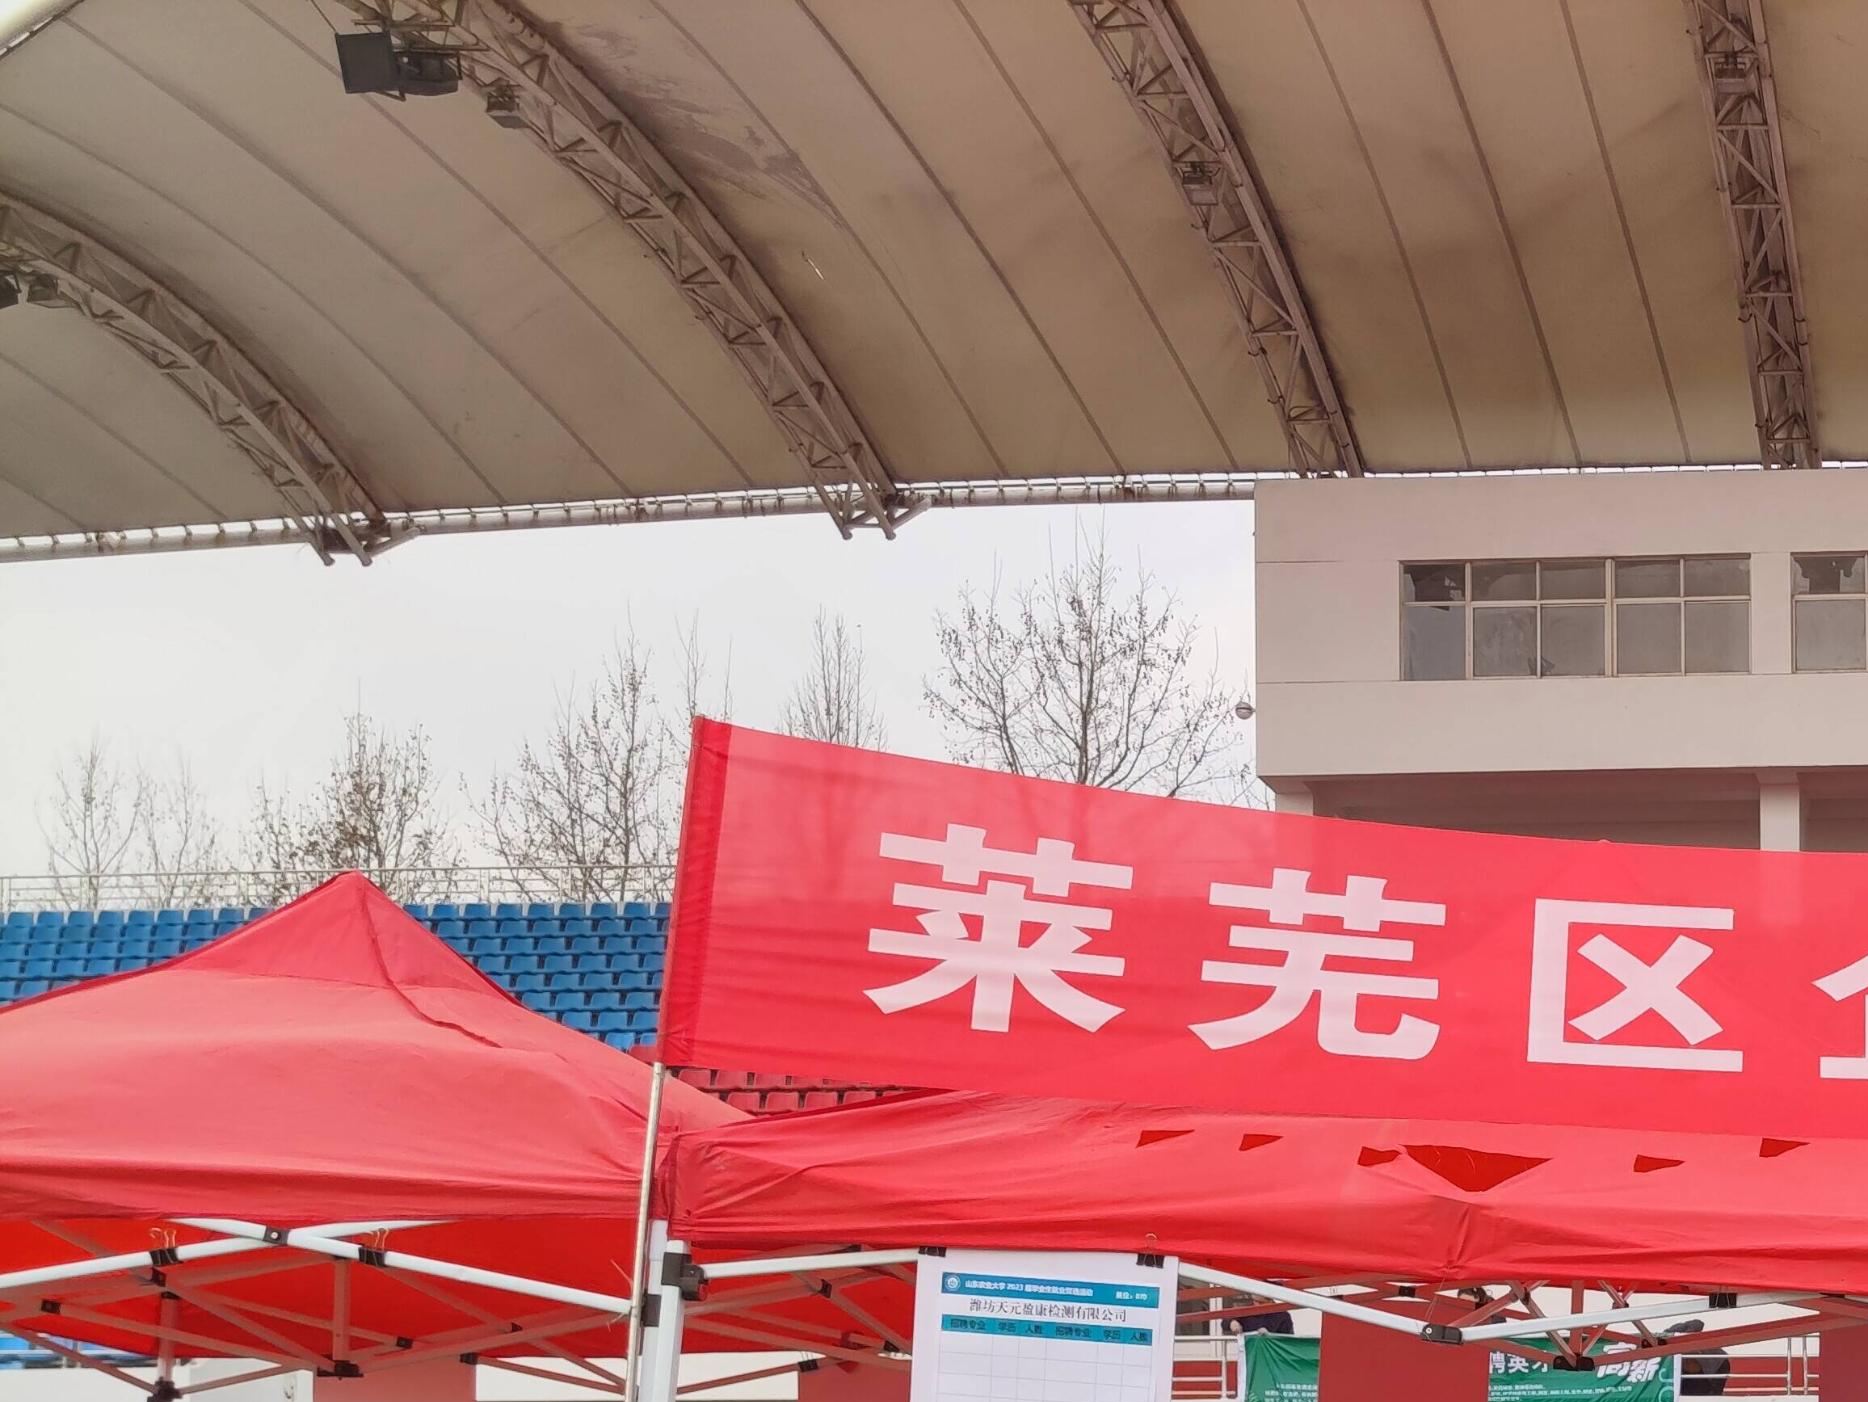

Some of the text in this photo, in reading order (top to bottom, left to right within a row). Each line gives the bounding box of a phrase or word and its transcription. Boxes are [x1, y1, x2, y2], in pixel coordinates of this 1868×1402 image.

[970, 1298, 1127, 1323] 潍坊天元盈康检测有限公司
